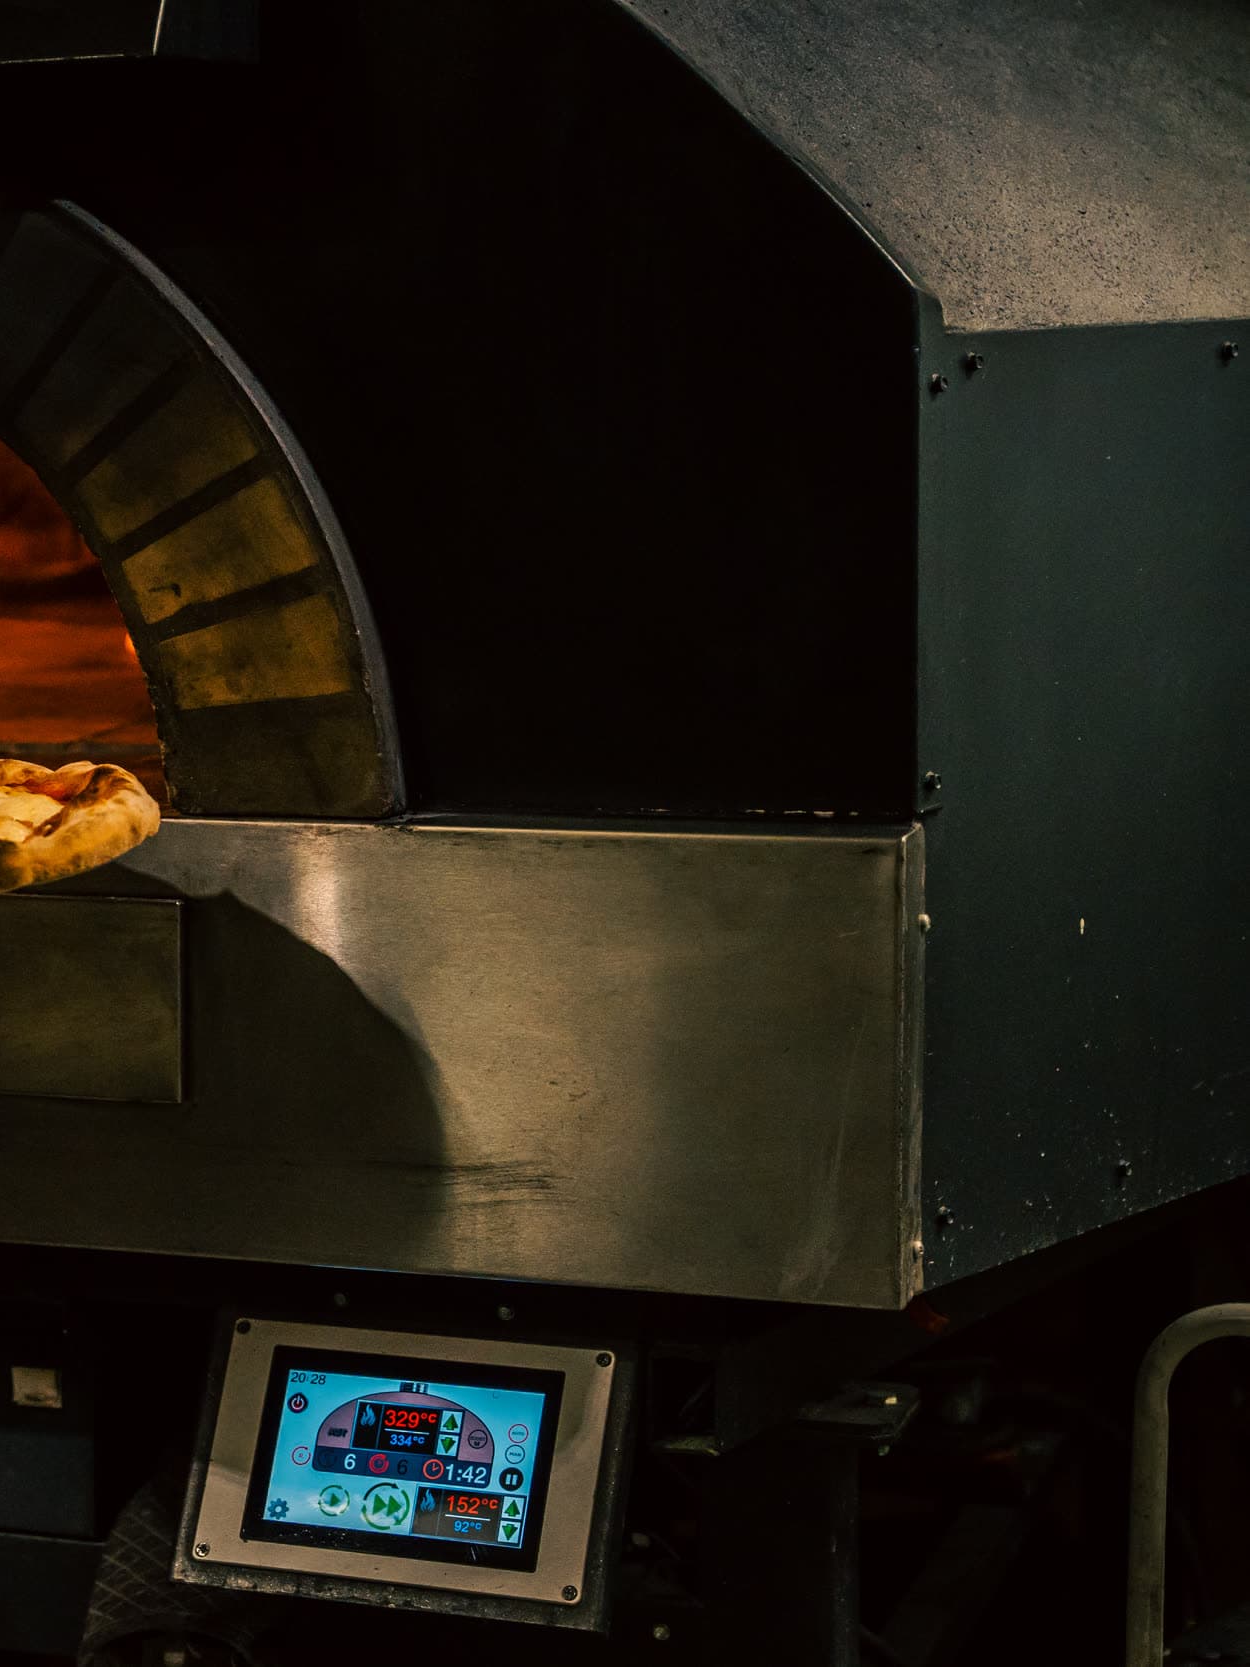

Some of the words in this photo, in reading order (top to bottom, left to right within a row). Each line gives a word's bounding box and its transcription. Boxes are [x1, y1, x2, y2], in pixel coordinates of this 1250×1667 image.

[384, 1409, 438, 1428] 329°C
[390, 1434, 425, 1447] 334°C
[344, 1454, 356, 1470] 6
[396, 1460, 409, 1475] 6
[446, 1464, 487, 1484] 1:42
[447, 1495, 499, 1514] 152°C
[454, 1519, 483, 1533] 92°C
